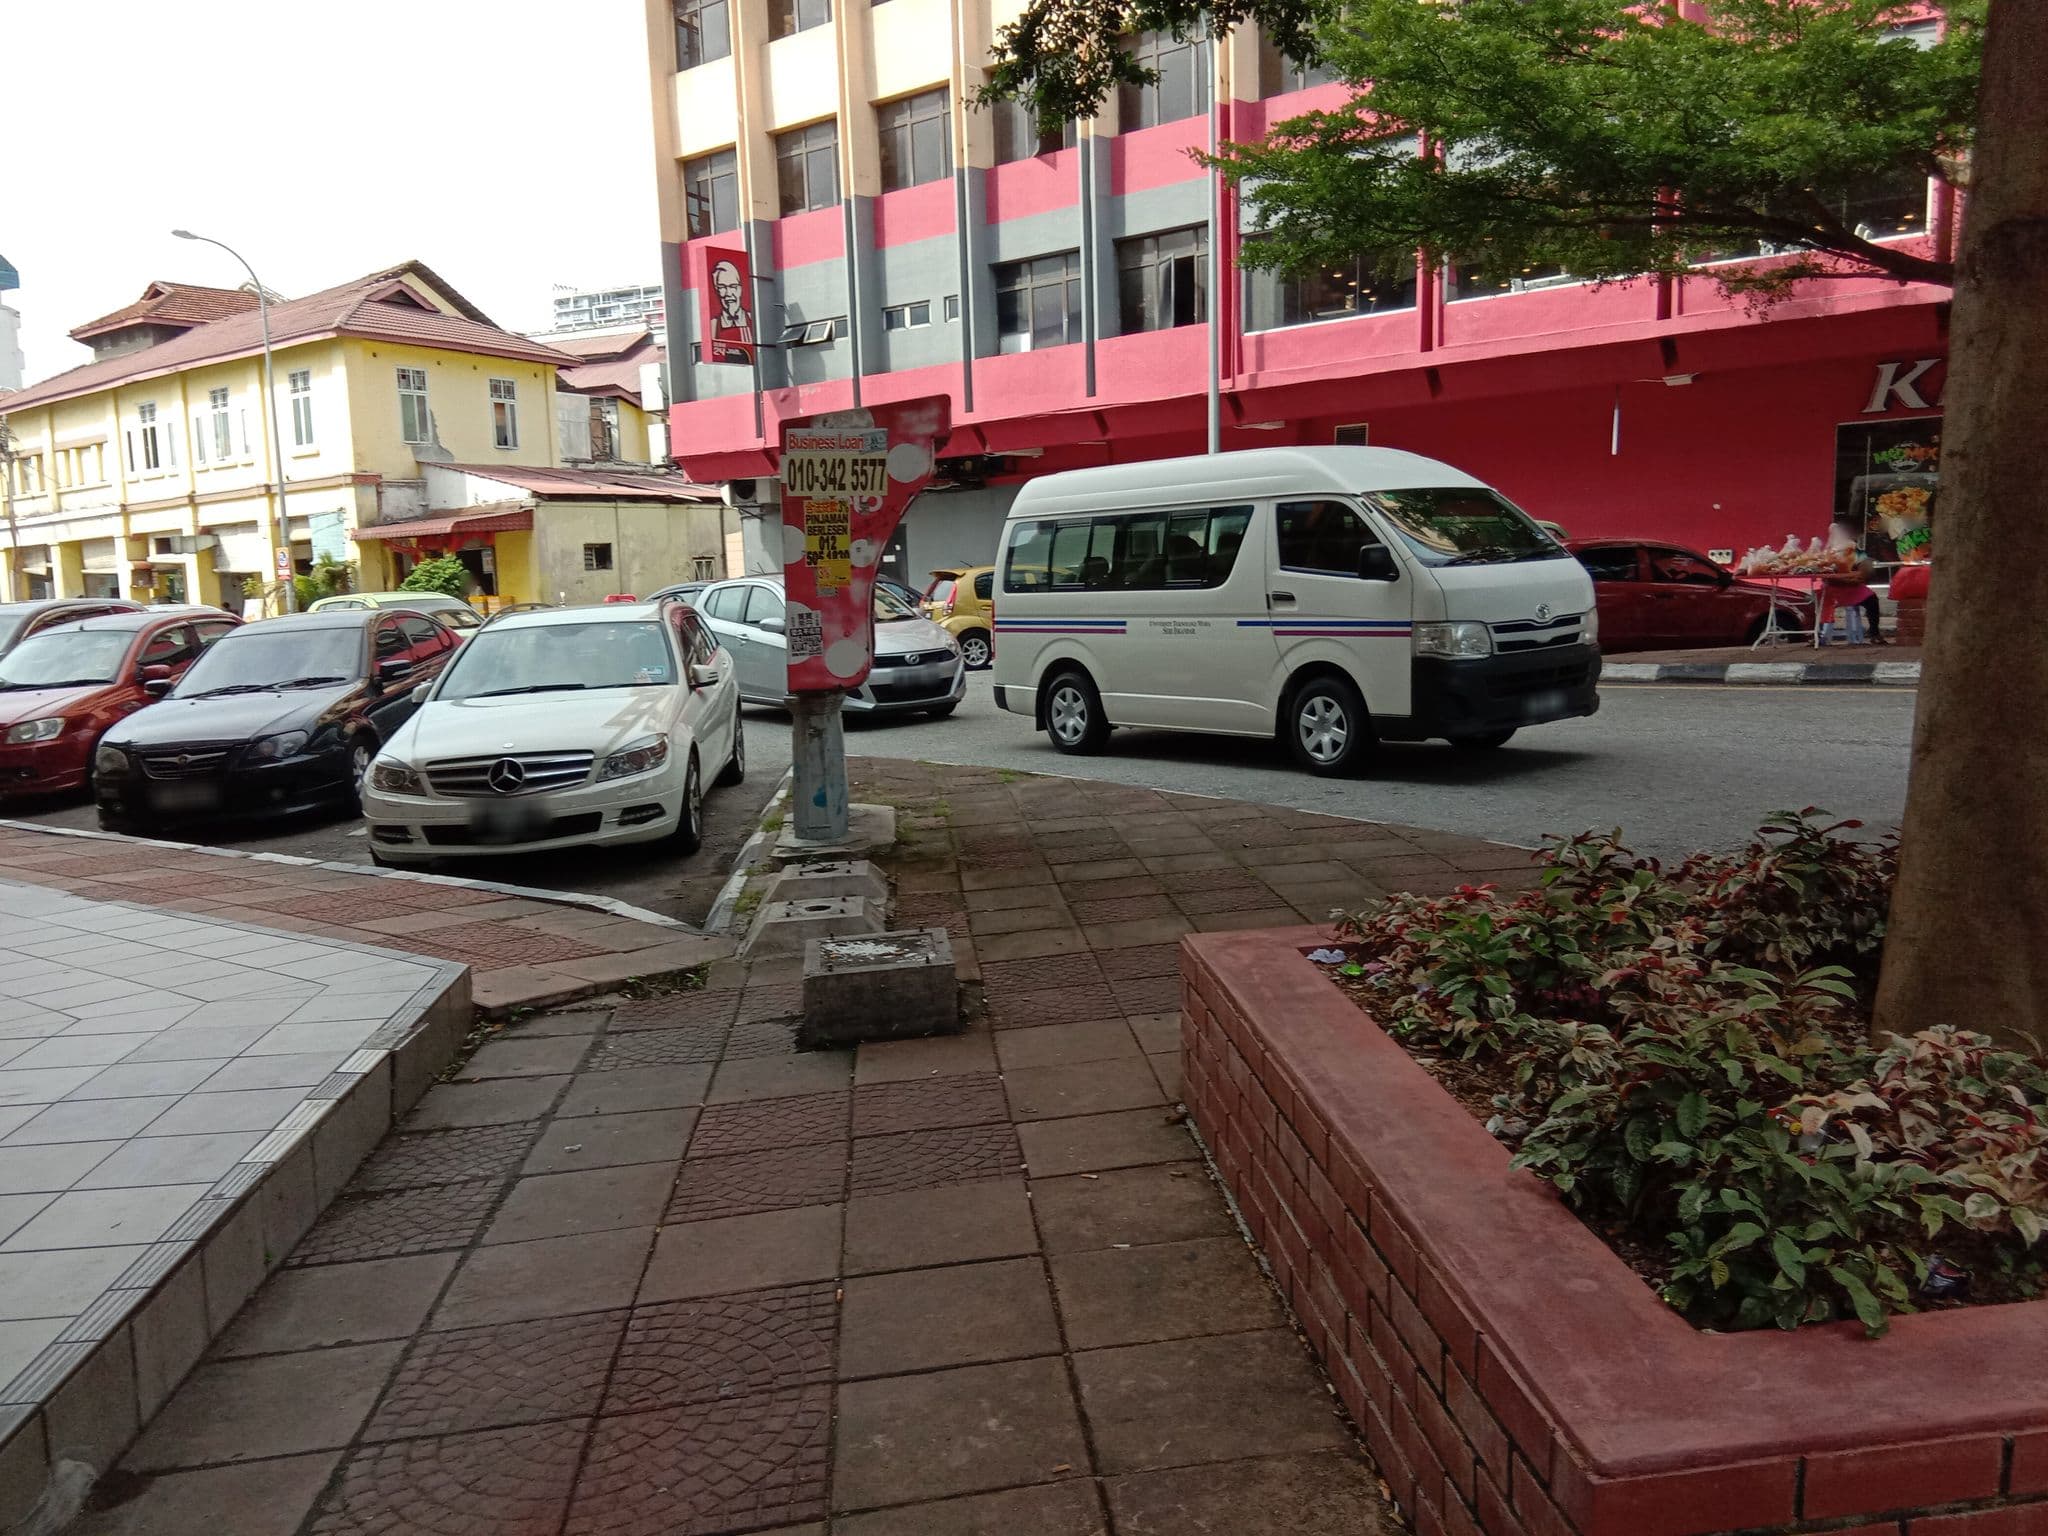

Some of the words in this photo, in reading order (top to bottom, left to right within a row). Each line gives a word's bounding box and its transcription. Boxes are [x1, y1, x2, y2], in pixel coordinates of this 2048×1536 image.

[1861, 358, 1944, 413] K
[789, 434, 835, 450] Business
[838, 433, 864, 449] Loan
[788, 458, 846, 492] 010-342
[851, 458, 887, 492] 5577
[806, 513, 849, 524] PINJAMAN
[807, 525, 848, 536] BERLESEN
[819, 536, 837, 550] 012
